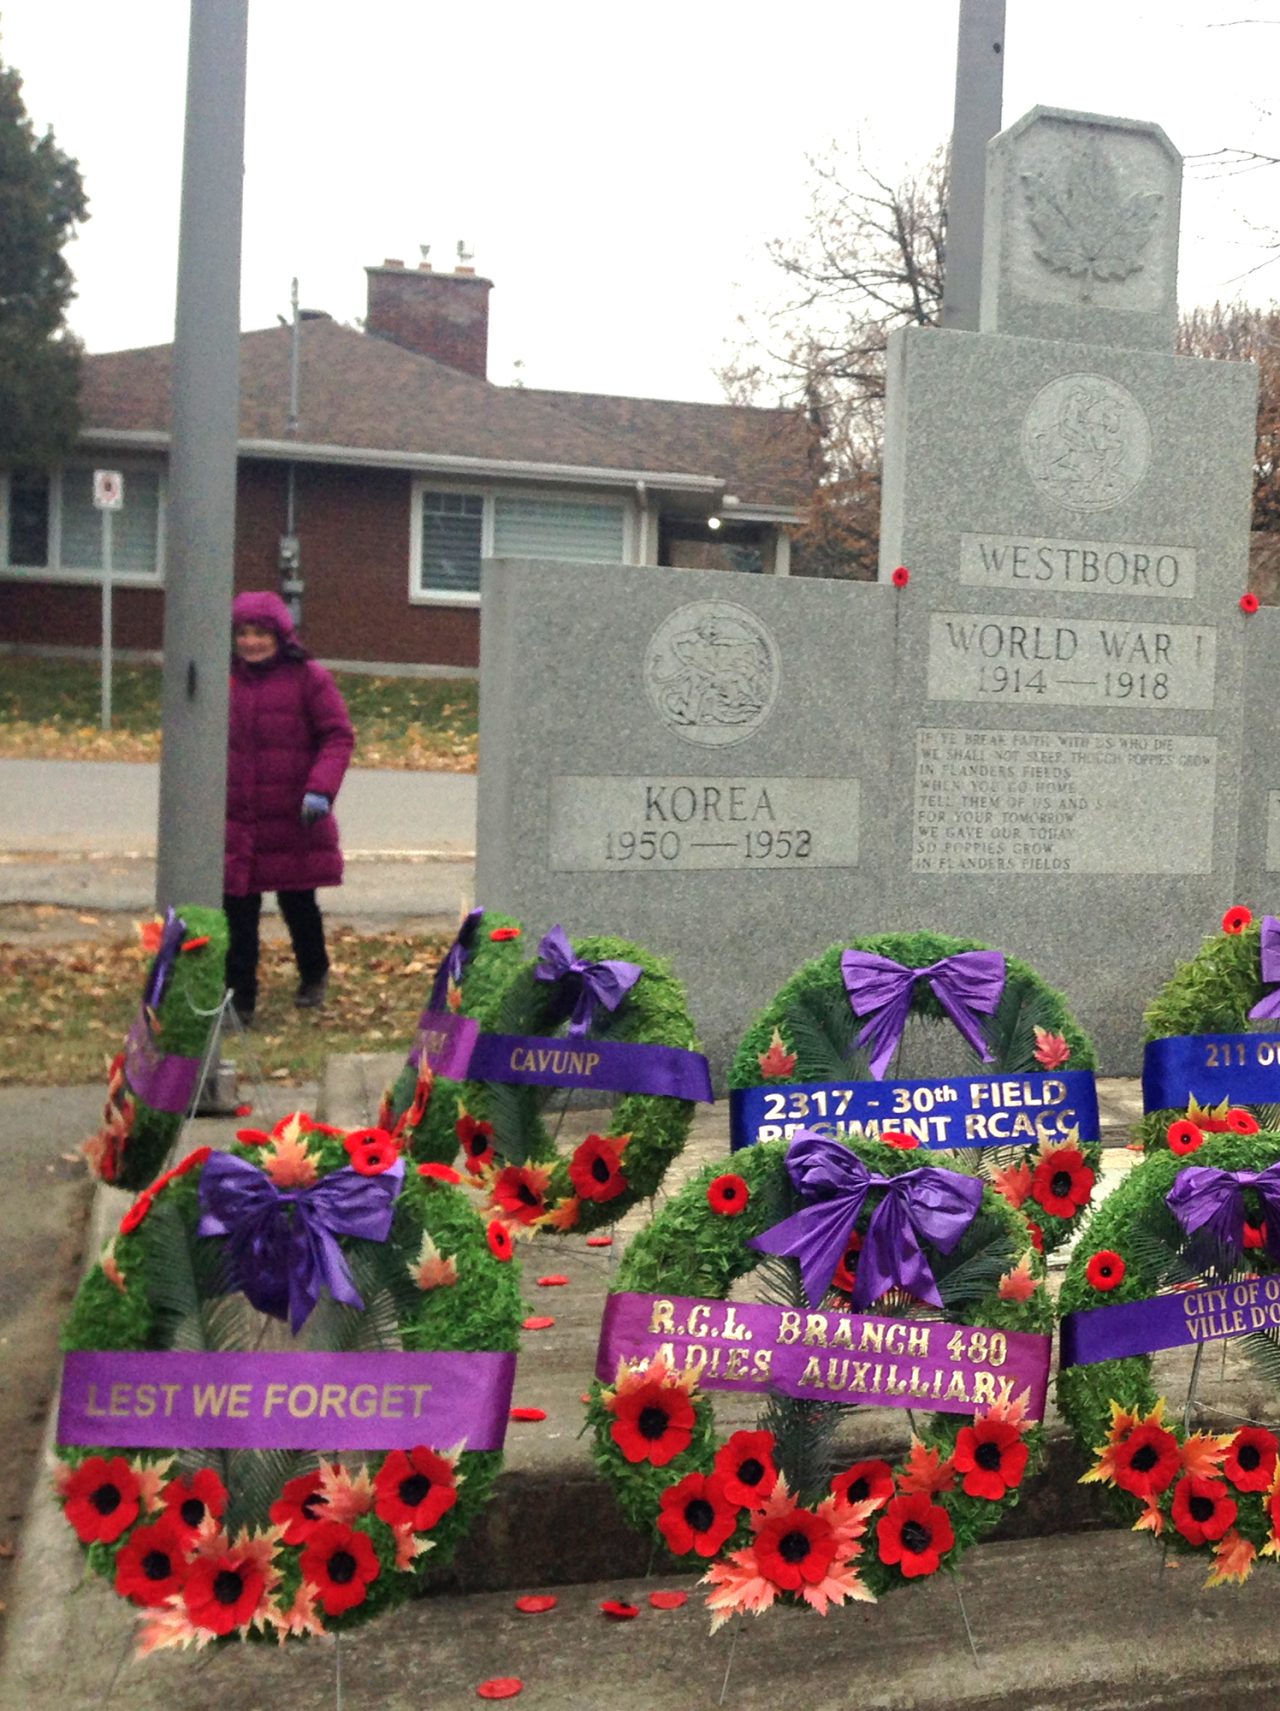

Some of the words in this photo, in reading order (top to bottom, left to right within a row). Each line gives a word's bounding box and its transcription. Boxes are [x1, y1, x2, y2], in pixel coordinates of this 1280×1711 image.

[979, 543, 1180, 589] WESTBORO
[946, 622, 1079, 662] WORLD
[1100, 630, 1173, 665] WAR
[1195, 636, 1204, 663] I
[921, 749, 939, 760] WE
[946, 750, 985, 761] SHALL
[993, 750, 1019, 762] NOT
[965, 734, 1007, 746] BREAK
[1058, 736, 1090, 748] WITH
[1119, 738, 1149, 750] WHO
[1154, 739, 1174, 750] DIE
[920, 764, 934, 775] IN
[942, 764, 1015, 777] FLANDERS
[1023, 766, 1071, 778] FIELDS
[920, 780, 960, 792] WHEN
[968, 780, 1000, 793] YOU
[1036, 782, 1076, 794] HOME
[645, 786, 776, 822] KOREA
[919, 795, 953, 807] TELL
[961, 796, 1000, 808] THEM
[1007, 797, 1024, 808] OF
[1060, 798, 1088, 810] AND
[919, 811, 945, 822] FOR
[954, 811, 993, 823] YOUR
[1002, 812, 1074, 824] TOMORROW
[919, 826, 938, 837] WE
[946, 827, 983, 839] GAVE
[990, 827, 1020, 839] OUR
[1029, 827, 1073, 840] TODAY
[945, 843, 1005, 855] POPPIES
[1012, 843, 1053, 855] GROW
[916, 858, 931, 869] IN
[939, 858, 1014, 870] FLANDERS
[1022, 859, 1071, 870] FIELDS
[510, 1048, 600, 1075] CAVUNP
[1205, 1043, 1246, 1067] 211
[763, 1090, 854, 1120] 2317
[892, 1085, 958, 1114] 30th
[970, 1080, 1068, 1109] FIELD
[965, 1109, 1077, 1141] RCACC
[1183, 1290, 1229, 1316] CITY
[1233, 1283, 1260, 1307] OF
[647, 1299, 752, 1342] R.C.L.
[776, 1310, 931, 1358] BRANCH
[946, 1329, 1008, 1367] 480
[1184, 1312, 1247, 1340] VILLE
[629, 1342, 773, 1384] ADIES
[798, 1355, 1018, 1404] AUXILLIARY
[87, 1383, 180, 1418] LEST
[192, 1384, 253, 1418] WE
[263, 1383, 432, 1419] FORGET
